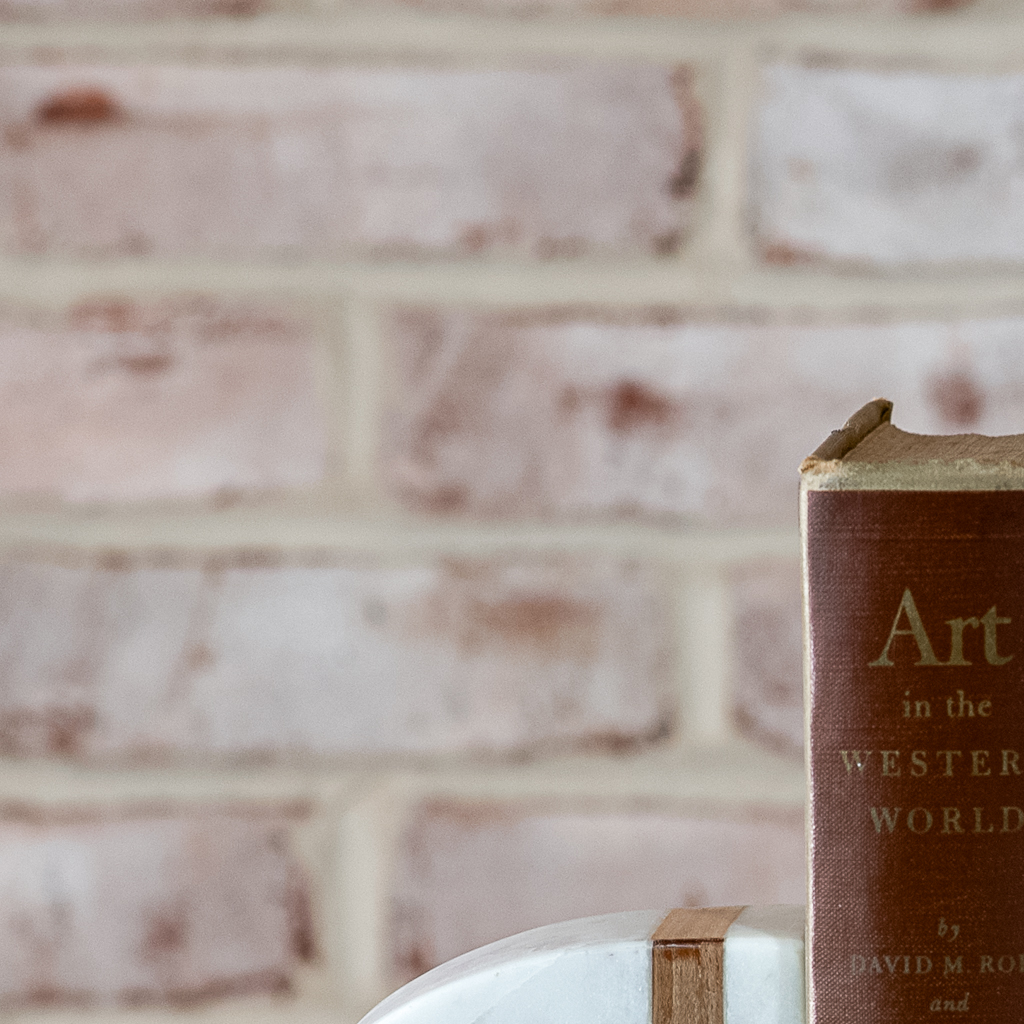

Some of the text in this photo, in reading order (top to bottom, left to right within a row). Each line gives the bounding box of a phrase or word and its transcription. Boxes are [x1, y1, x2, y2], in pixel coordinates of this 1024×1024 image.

[867, 587, 1014, 667] Art
[902, 690, 992, 718] in the
[937, 917, 960, 942] by
[851, 955, 932, 975] DAVID
[929, 992, 970, 1012] and
